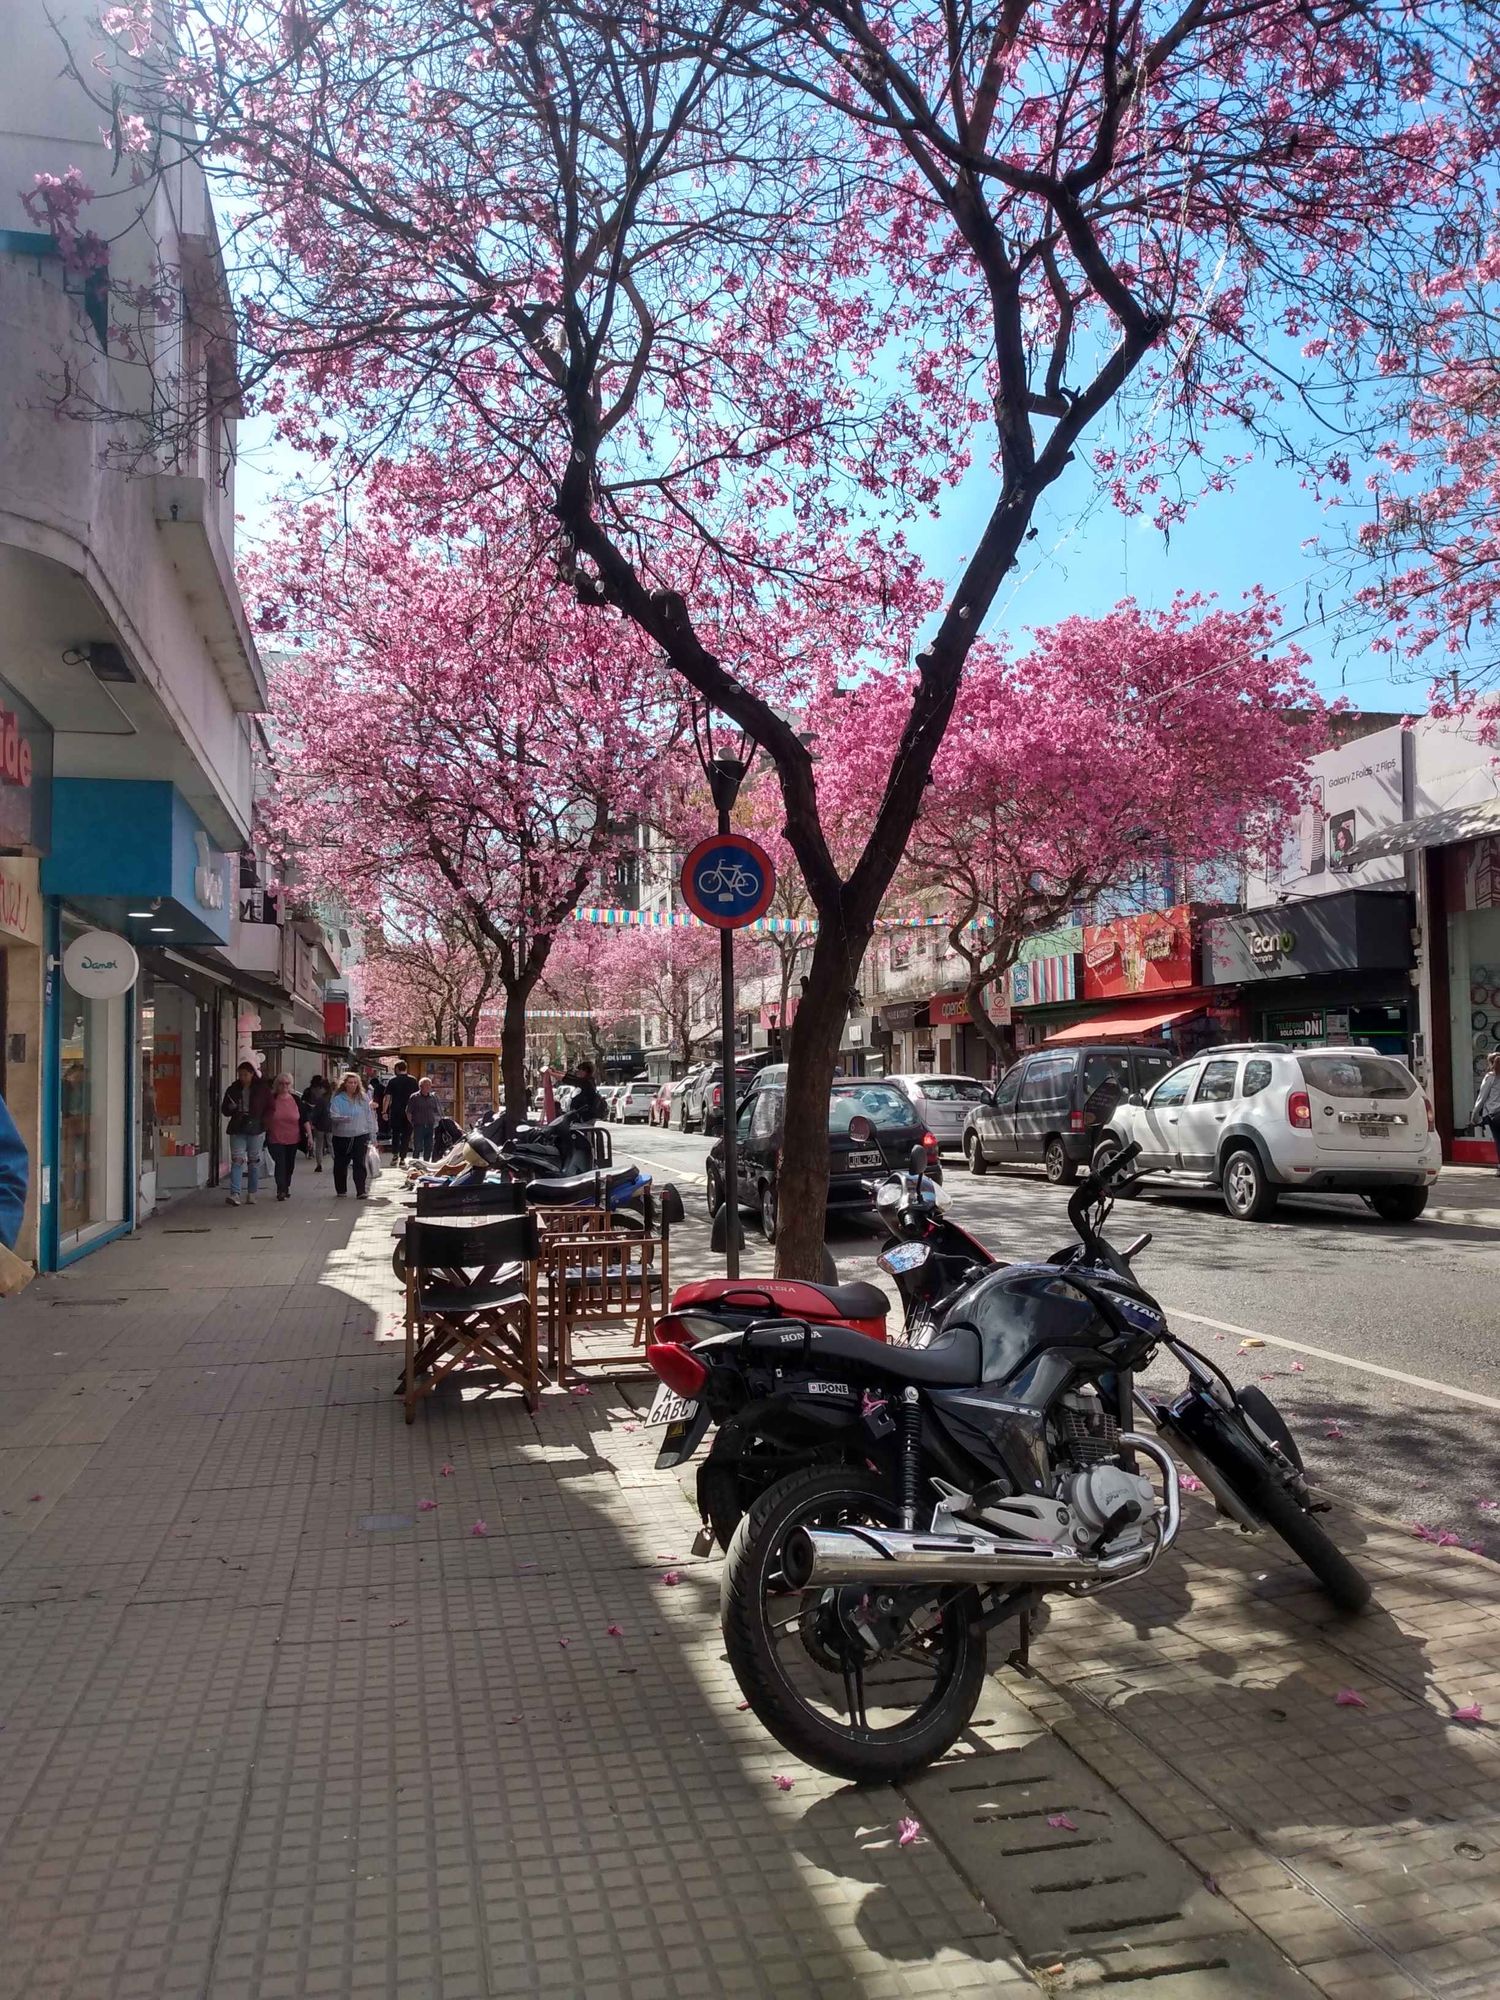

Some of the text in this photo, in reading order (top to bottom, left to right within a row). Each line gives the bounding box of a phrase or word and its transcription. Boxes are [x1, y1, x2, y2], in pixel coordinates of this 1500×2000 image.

[1328, 775, 1351, 788] Galaxy
[1380, 758, 1397, 772] Flip5
[1280, 1029, 1293, 1037] SOLO
[1294, 1028, 1305, 1036] CON
[1304, 1019, 1323, 1037] DNI
[757, 1284, 796, 1294] GILERA
[1112, 1296, 1160, 1321] TITAN
[780, 1331, 823, 1343] HONA
[818, 1383, 848, 1394] IPONE
